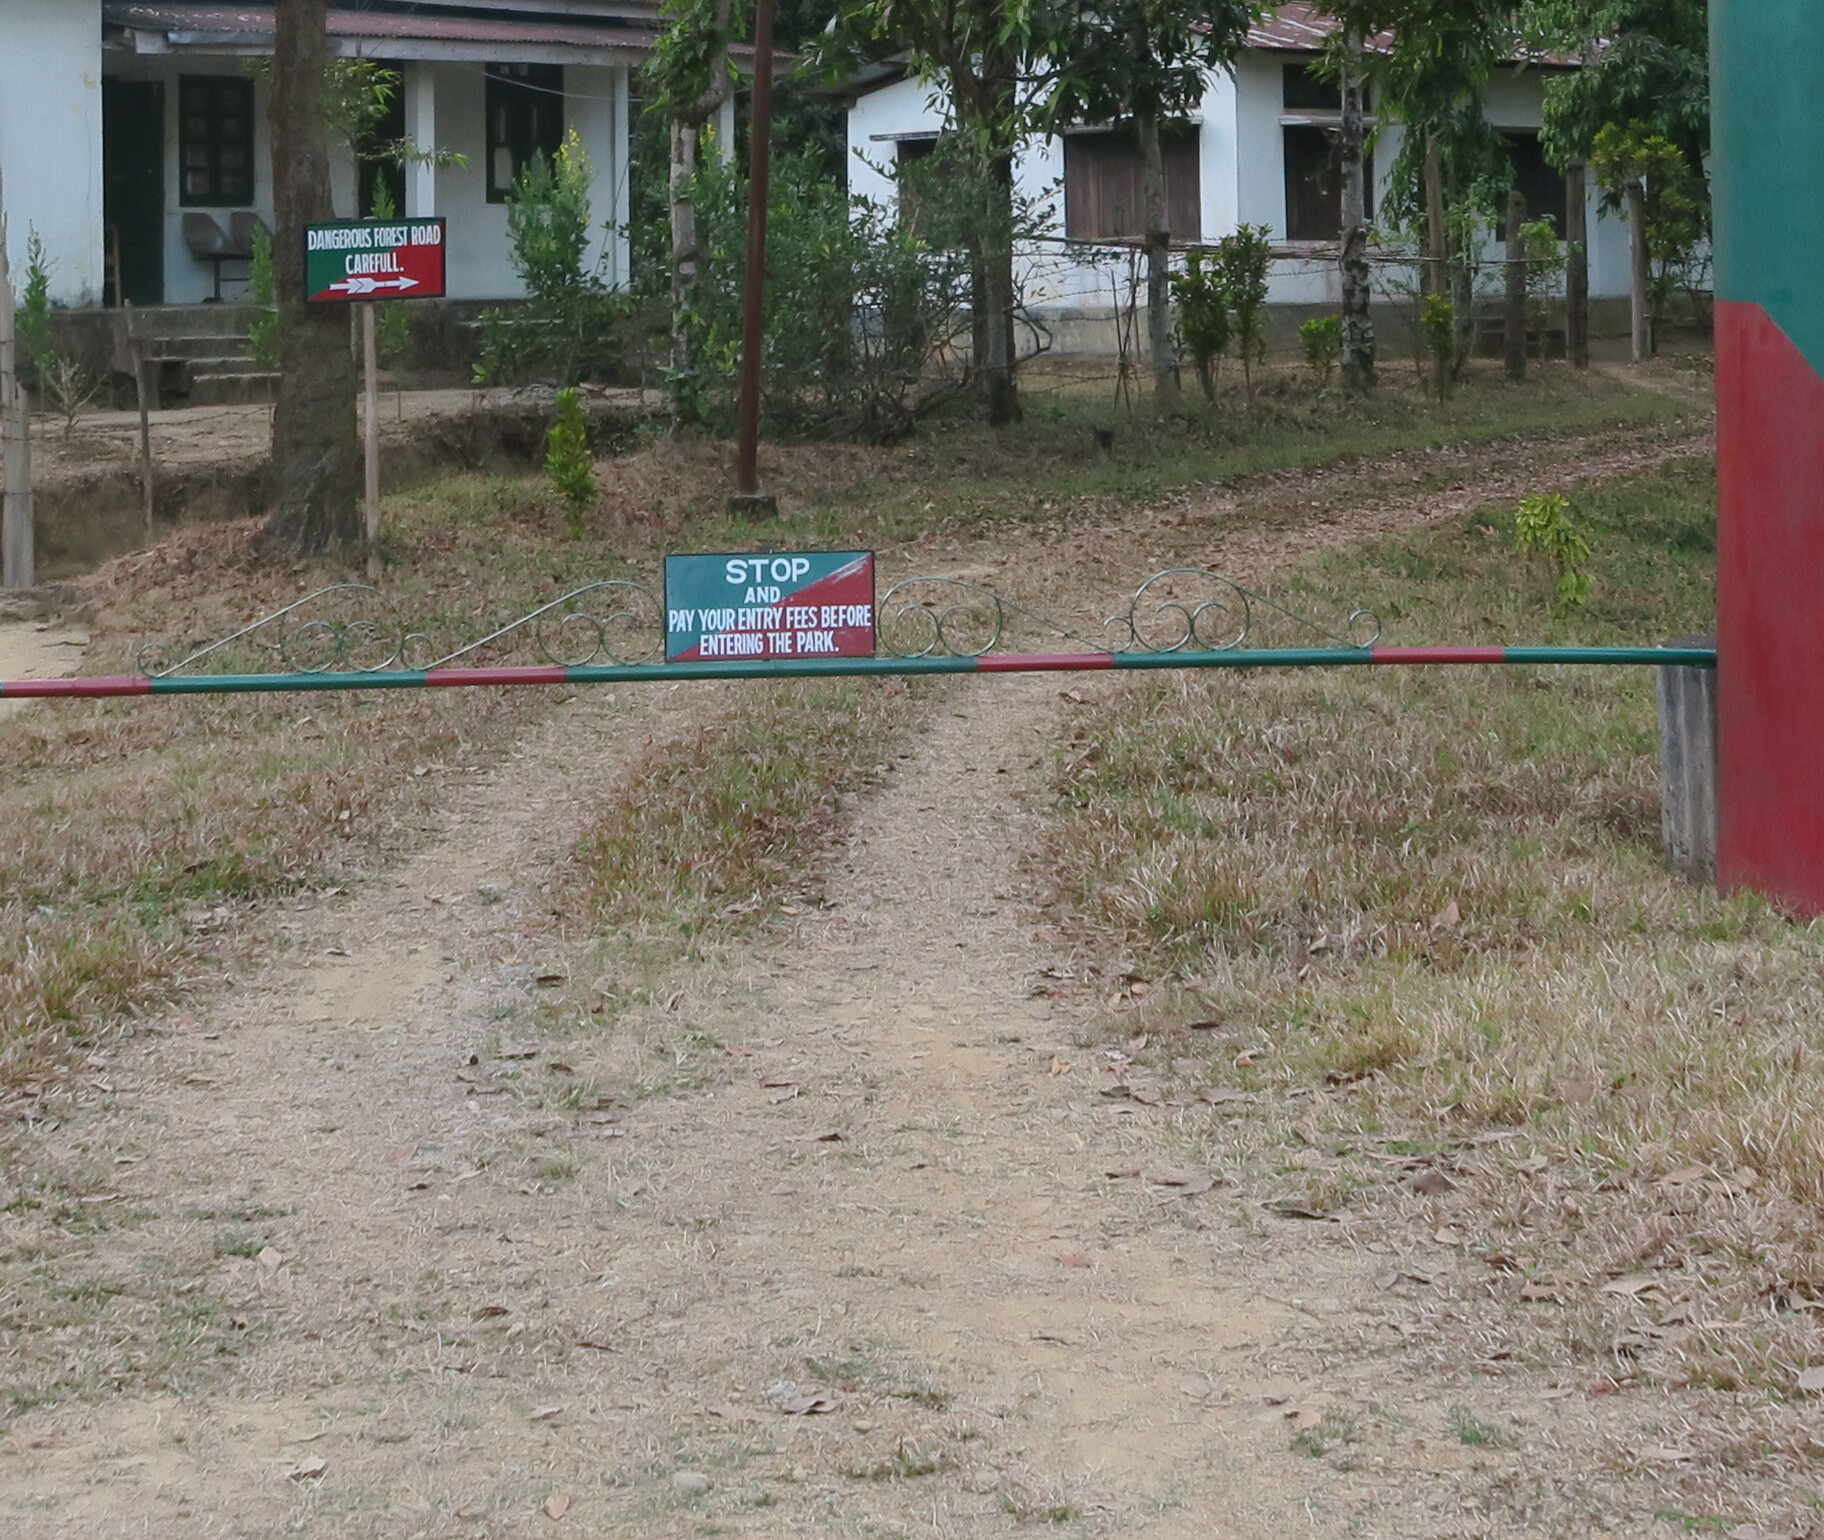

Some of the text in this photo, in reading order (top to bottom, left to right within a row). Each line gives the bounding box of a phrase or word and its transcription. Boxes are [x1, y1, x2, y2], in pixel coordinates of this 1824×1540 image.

[308, 225, 441, 250] DANGEROUS FOREST ROAD
[345, 252, 404, 274] CAREFULL.
[726, 558, 810, 584] STOP
[669, 605, 872, 633] PAY YOUR ENTRY FEES BEFORE
[700, 630, 839, 656] ENTERING THE PARK.
